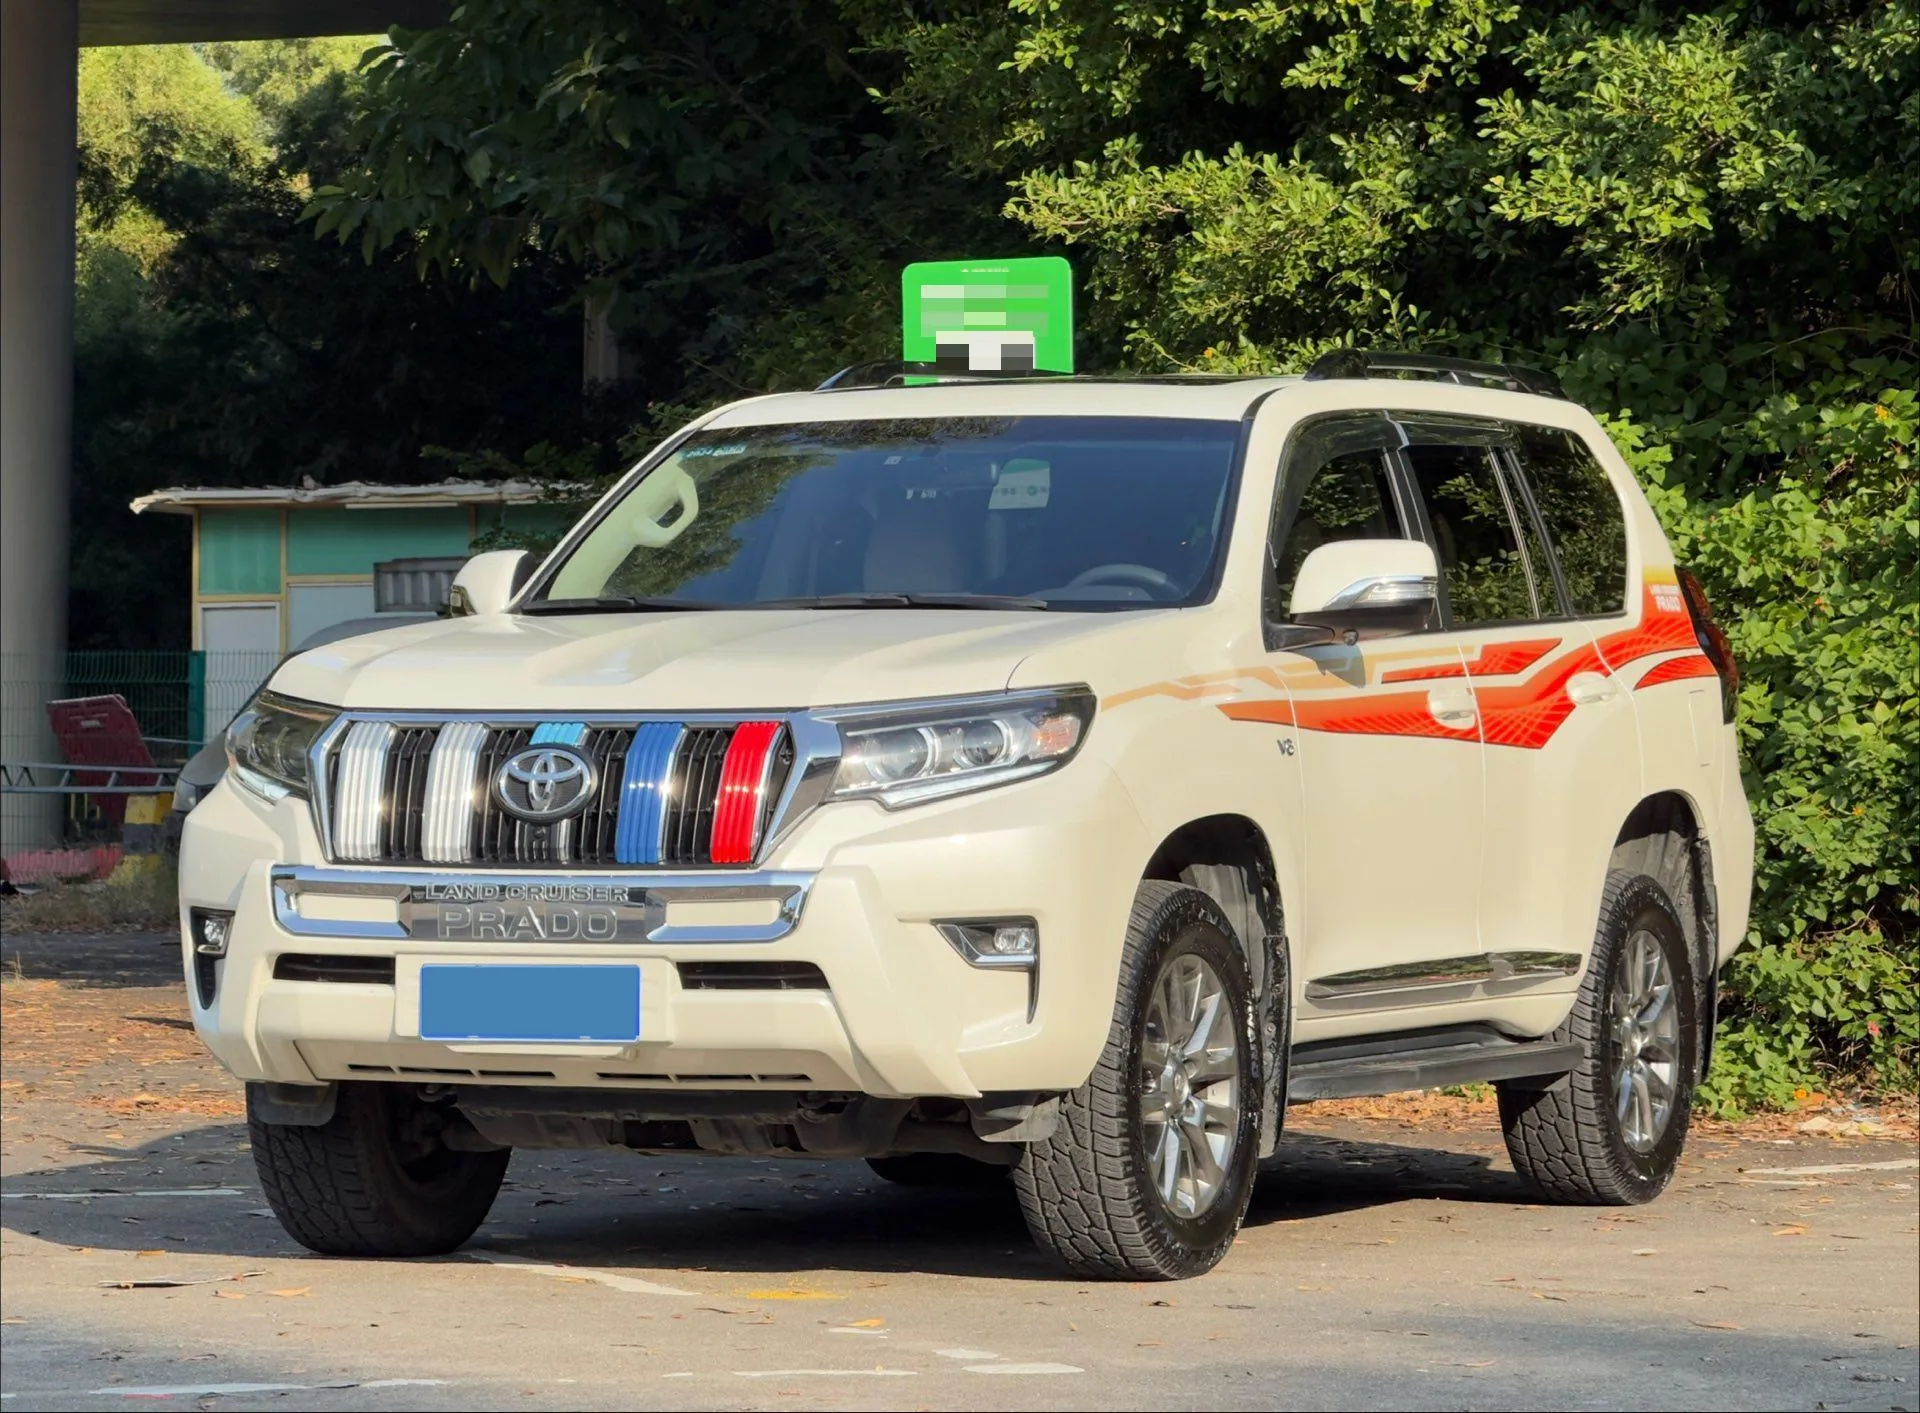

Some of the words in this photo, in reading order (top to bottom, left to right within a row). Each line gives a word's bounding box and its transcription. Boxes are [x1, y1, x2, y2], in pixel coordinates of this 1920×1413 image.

[425, 881, 499, 900] LAND
[504, 883, 629, 901] CRUISER
[437, 903, 618, 941] PRADO
